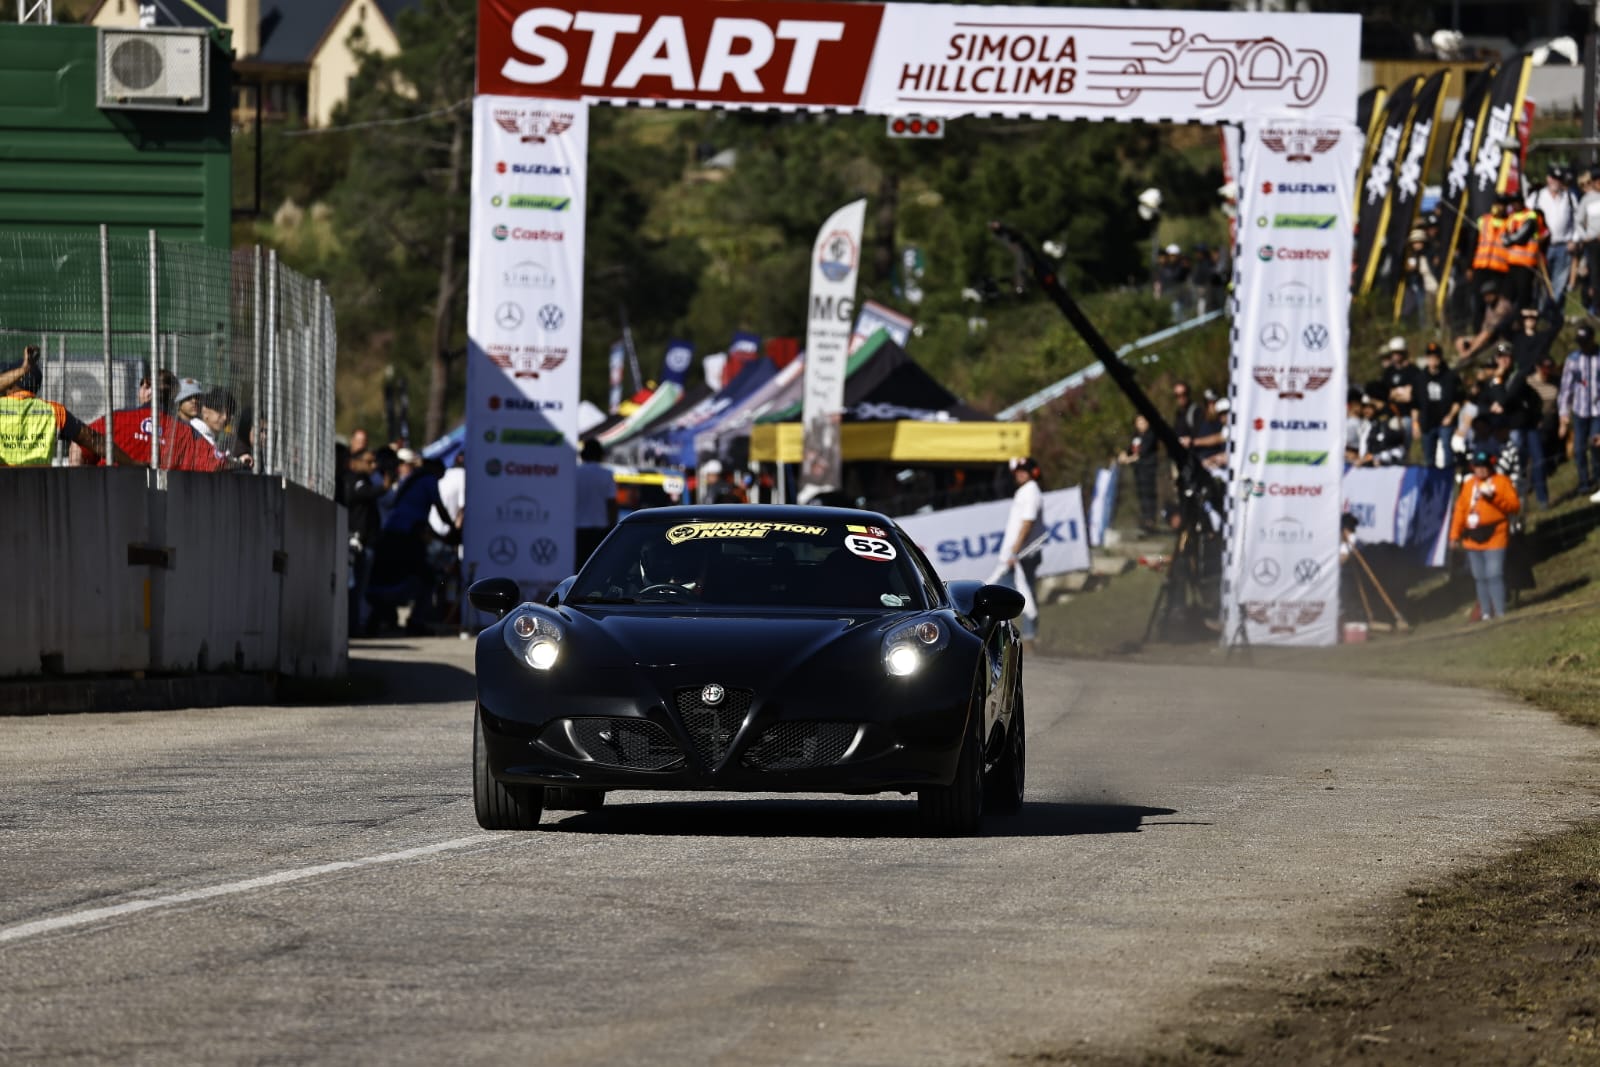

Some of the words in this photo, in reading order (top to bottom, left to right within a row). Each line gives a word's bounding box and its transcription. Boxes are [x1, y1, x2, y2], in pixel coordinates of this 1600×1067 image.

[500, 7, 845, 95] START
[946, 33, 1077, 63] SIMOLA
[898, 63, 1078, 94] HILLCLIMB
[511, 163, 571, 175] SUZUKI
[1277, 183, 1336, 195] SUZUKI
[511, 226, 565, 242] Castrol
[1276, 246, 1331, 261] Castrol
[811, 294, 855, 322] MG
[1270, 419, 1327, 431] SUZUKI
[503, 461, 559, 477] Castrol
[1268, 483, 1323, 497] Castrol
[699, 529, 768, 538] NOISE
[705, 521, 823, 535] INDUCTION
[852, 538, 892, 557] 52
[936, 519, 1079, 563] SUZKI
